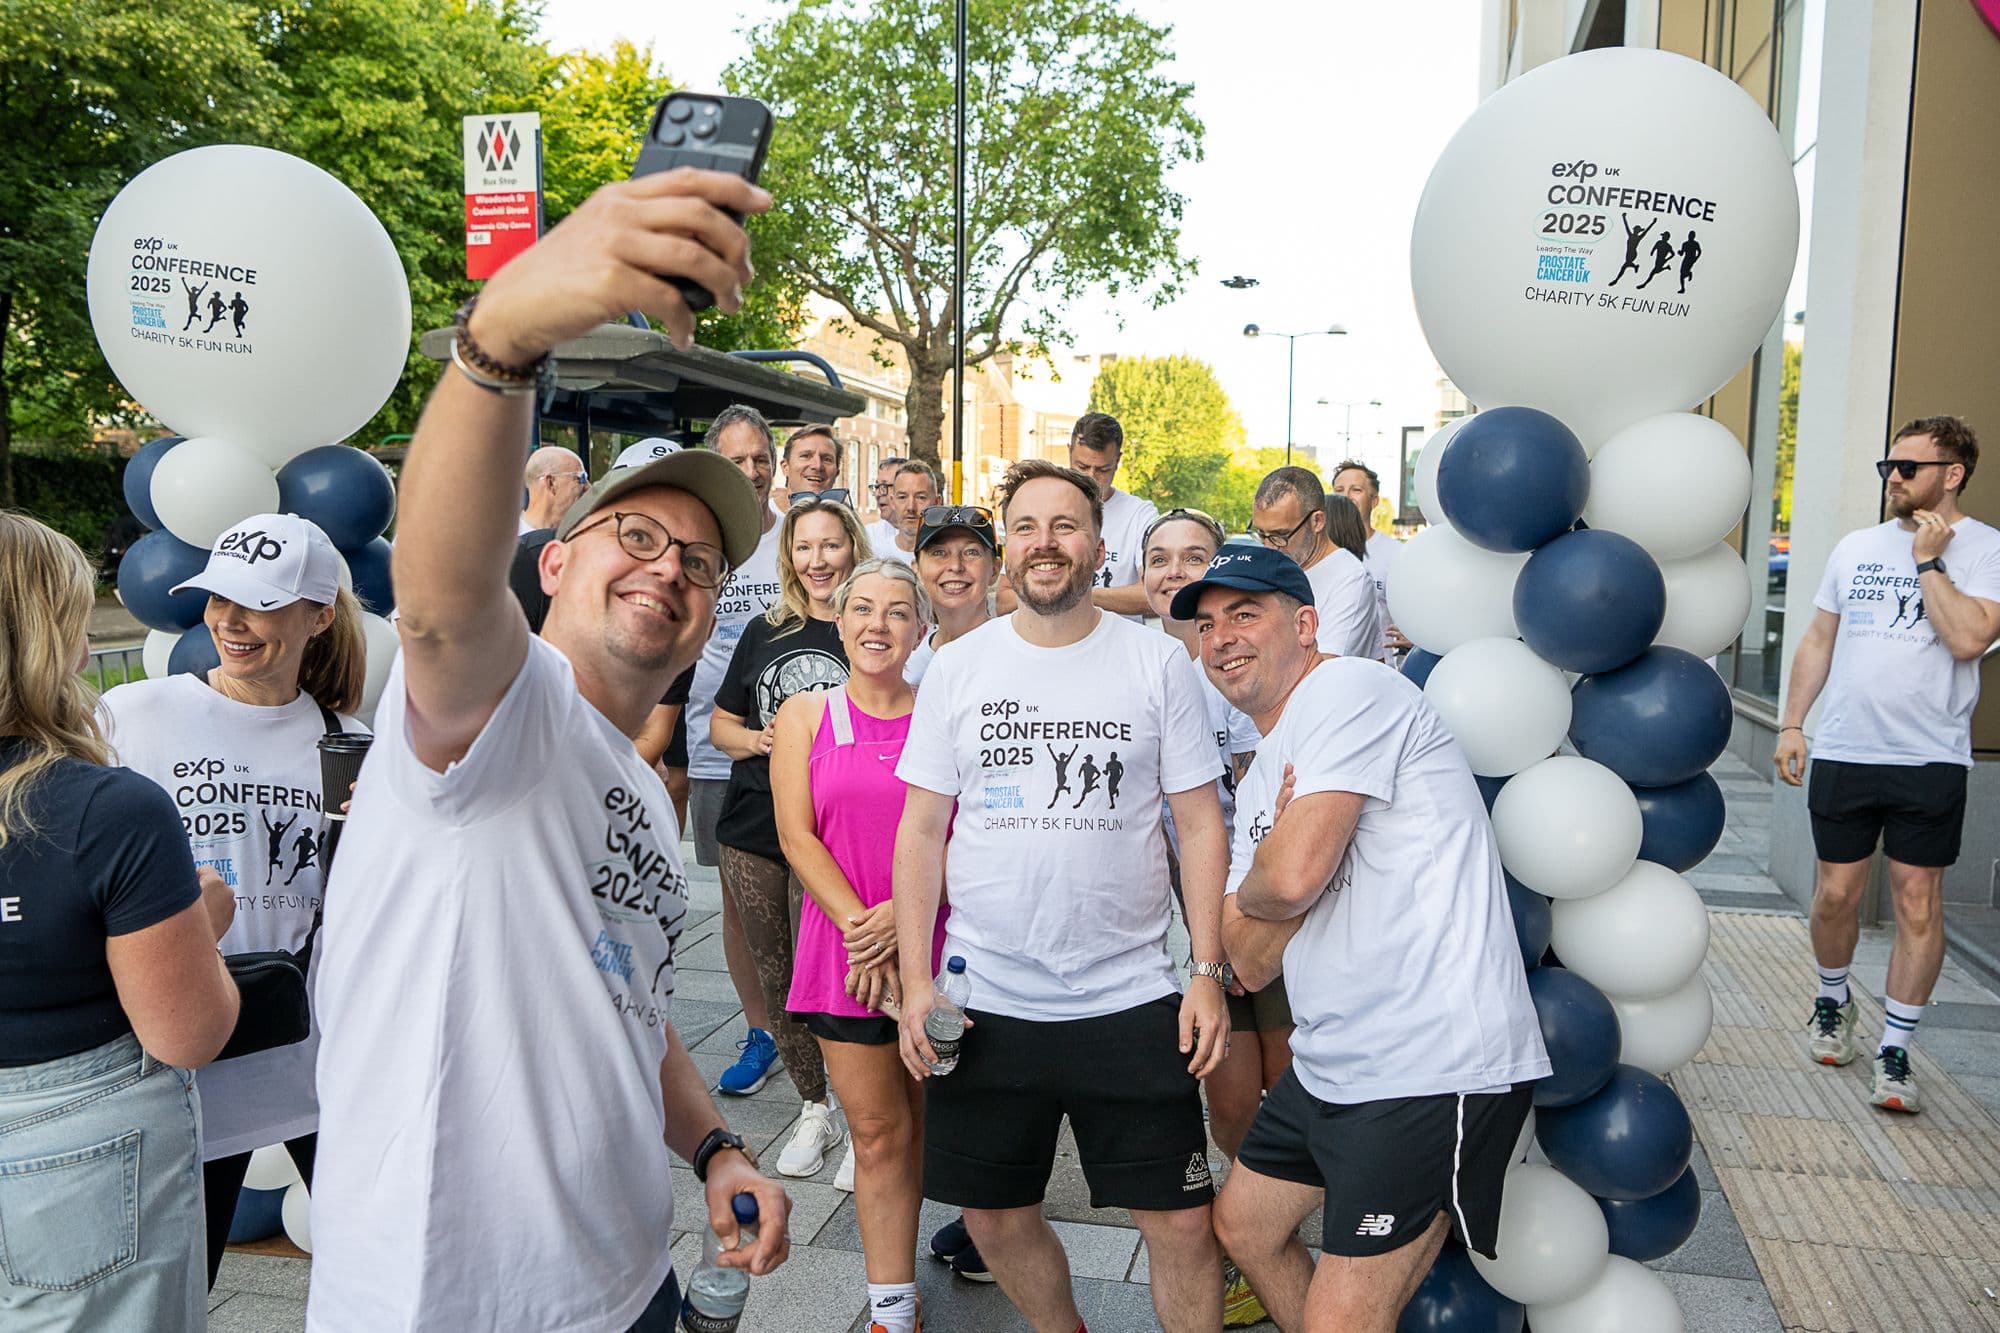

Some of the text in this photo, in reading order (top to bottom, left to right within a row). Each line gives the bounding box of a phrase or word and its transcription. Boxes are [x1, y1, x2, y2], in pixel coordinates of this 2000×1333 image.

[1605, 168, 1620, 176] UK
[499, 177, 517, 185] Stop
[506, 205, 529, 215] Street
[1548, 185, 1717, 222] CONFERENCE
[496, 222, 509, 231] City
[1542, 213, 1606, 235] 2025
[1539, 255, 1586, 270] PROSTATE
[131, 255, 257, 285] CONFERENCE
[1537, 268, 1591, 283] CANCER UK
[131, 275, 171, 293] 2025
[1525, 286, 1690, 317] CHARITY 5K FUN RUN
[132, 305, 162, 319] PROSTATE
[131, 327, 252, 354] CHARITY 5K FUN RUN
[1853, 575, 1920, 588] CONFERE
[1848, 588, 1885, 600] 2025
[715, 601, 751, 615] 2025
[1026, 705, 1039, 713] UK
[980, 721, 1132, 742] CONFERENCE
[980, 747, 1034, 768] 2025
[234, 765, 250, 774] UK
[176, 782, 321, 813] CONFEREN
[984, 785, 1021, 798] PROSTATE
[984, 797, 1025, 809] CANCER UK
[182, 812, 247, 838] 2025
[984, 817, 1123, 831] CHARITY 5K FUN RUN
[279, 896, 305, 909] FUN
